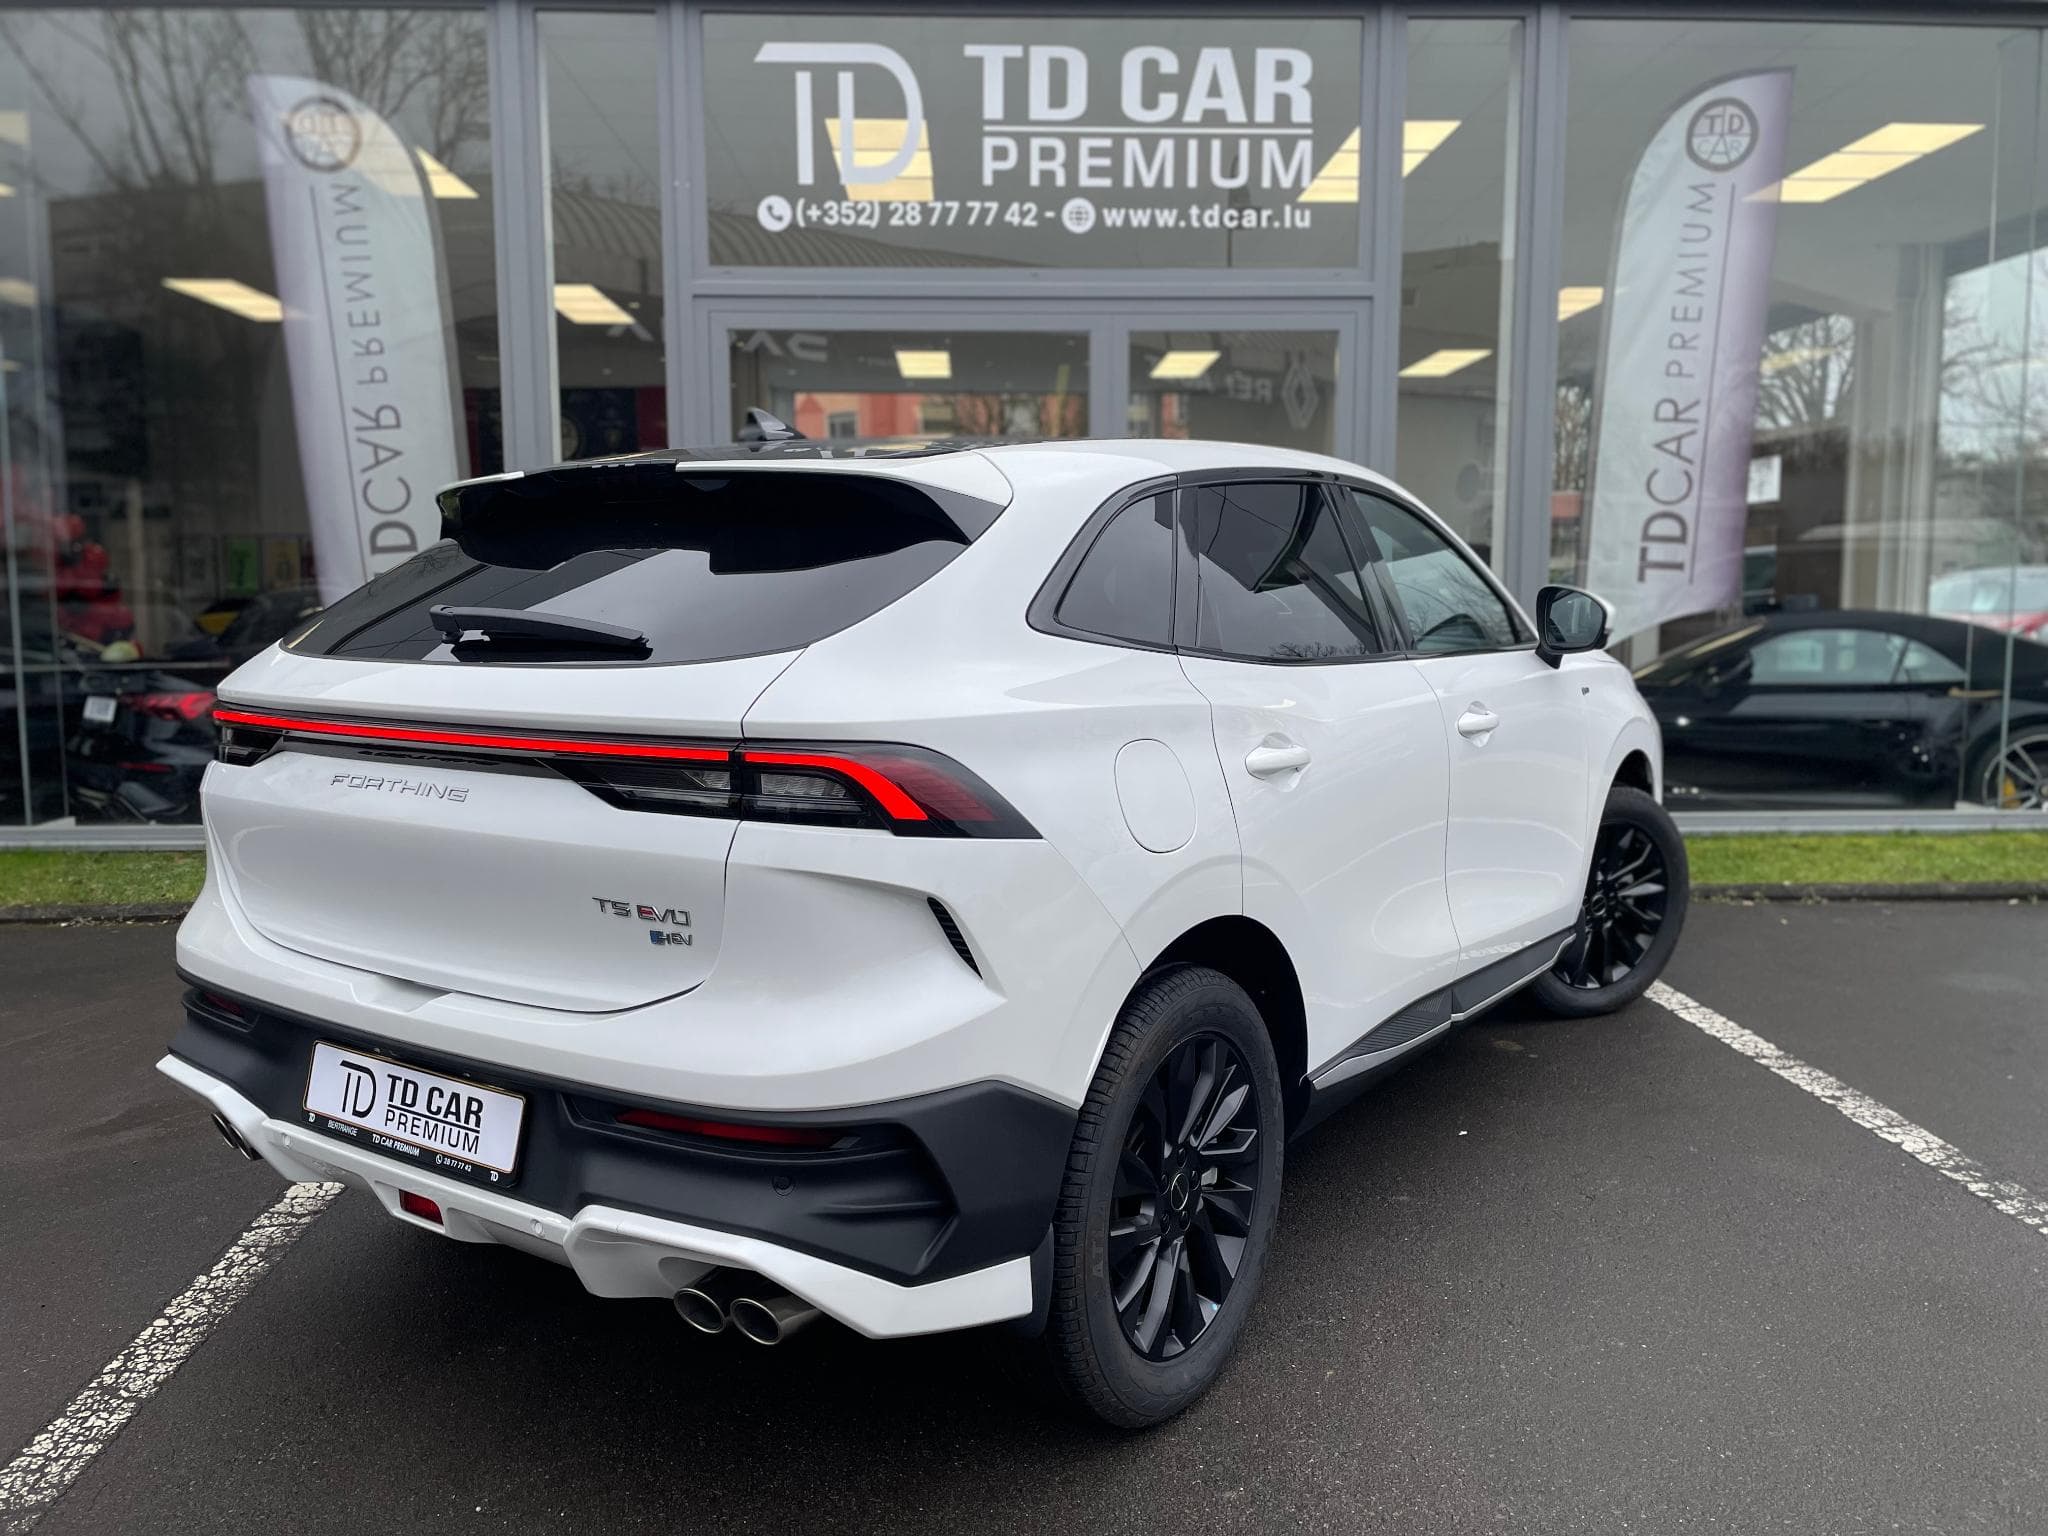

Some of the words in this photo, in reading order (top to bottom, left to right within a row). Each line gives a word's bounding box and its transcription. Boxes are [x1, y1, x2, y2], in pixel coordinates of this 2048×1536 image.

[963, 45, 1088, 121] TD
[1120, 45, 1313, 124] CAR
[1702, 112, 1745, 134] TD
[981, 137, 1313, 189] PREMIUM
[796, 197, 881, 229] (+352)
[888, 201, 922, 227] 28
[928, 201, 960, 227] 77
[966, 201, 999, 227] 77
[1003, 201, 1039, 228] 42
[1102, 203, 1313, 229] www.tdcar.lu
[1664, 182, 1717, 379] PREMIUM
[1637, 397, 1700, 583] TDCAR
[331, 773, 470, 803] FORTHING
[637, 904, 692, 928] EVO
[387, 1073, 419, 1108] TD
[426, 1086, 485, 1129] CAR
[371, 1133, 381, 1144] TD
[380, 1136, 395, 1149] CAR
[393, 1141, 420, 1157] PREMIUM
[384, 1108, 481, 1155] PREMIUM
